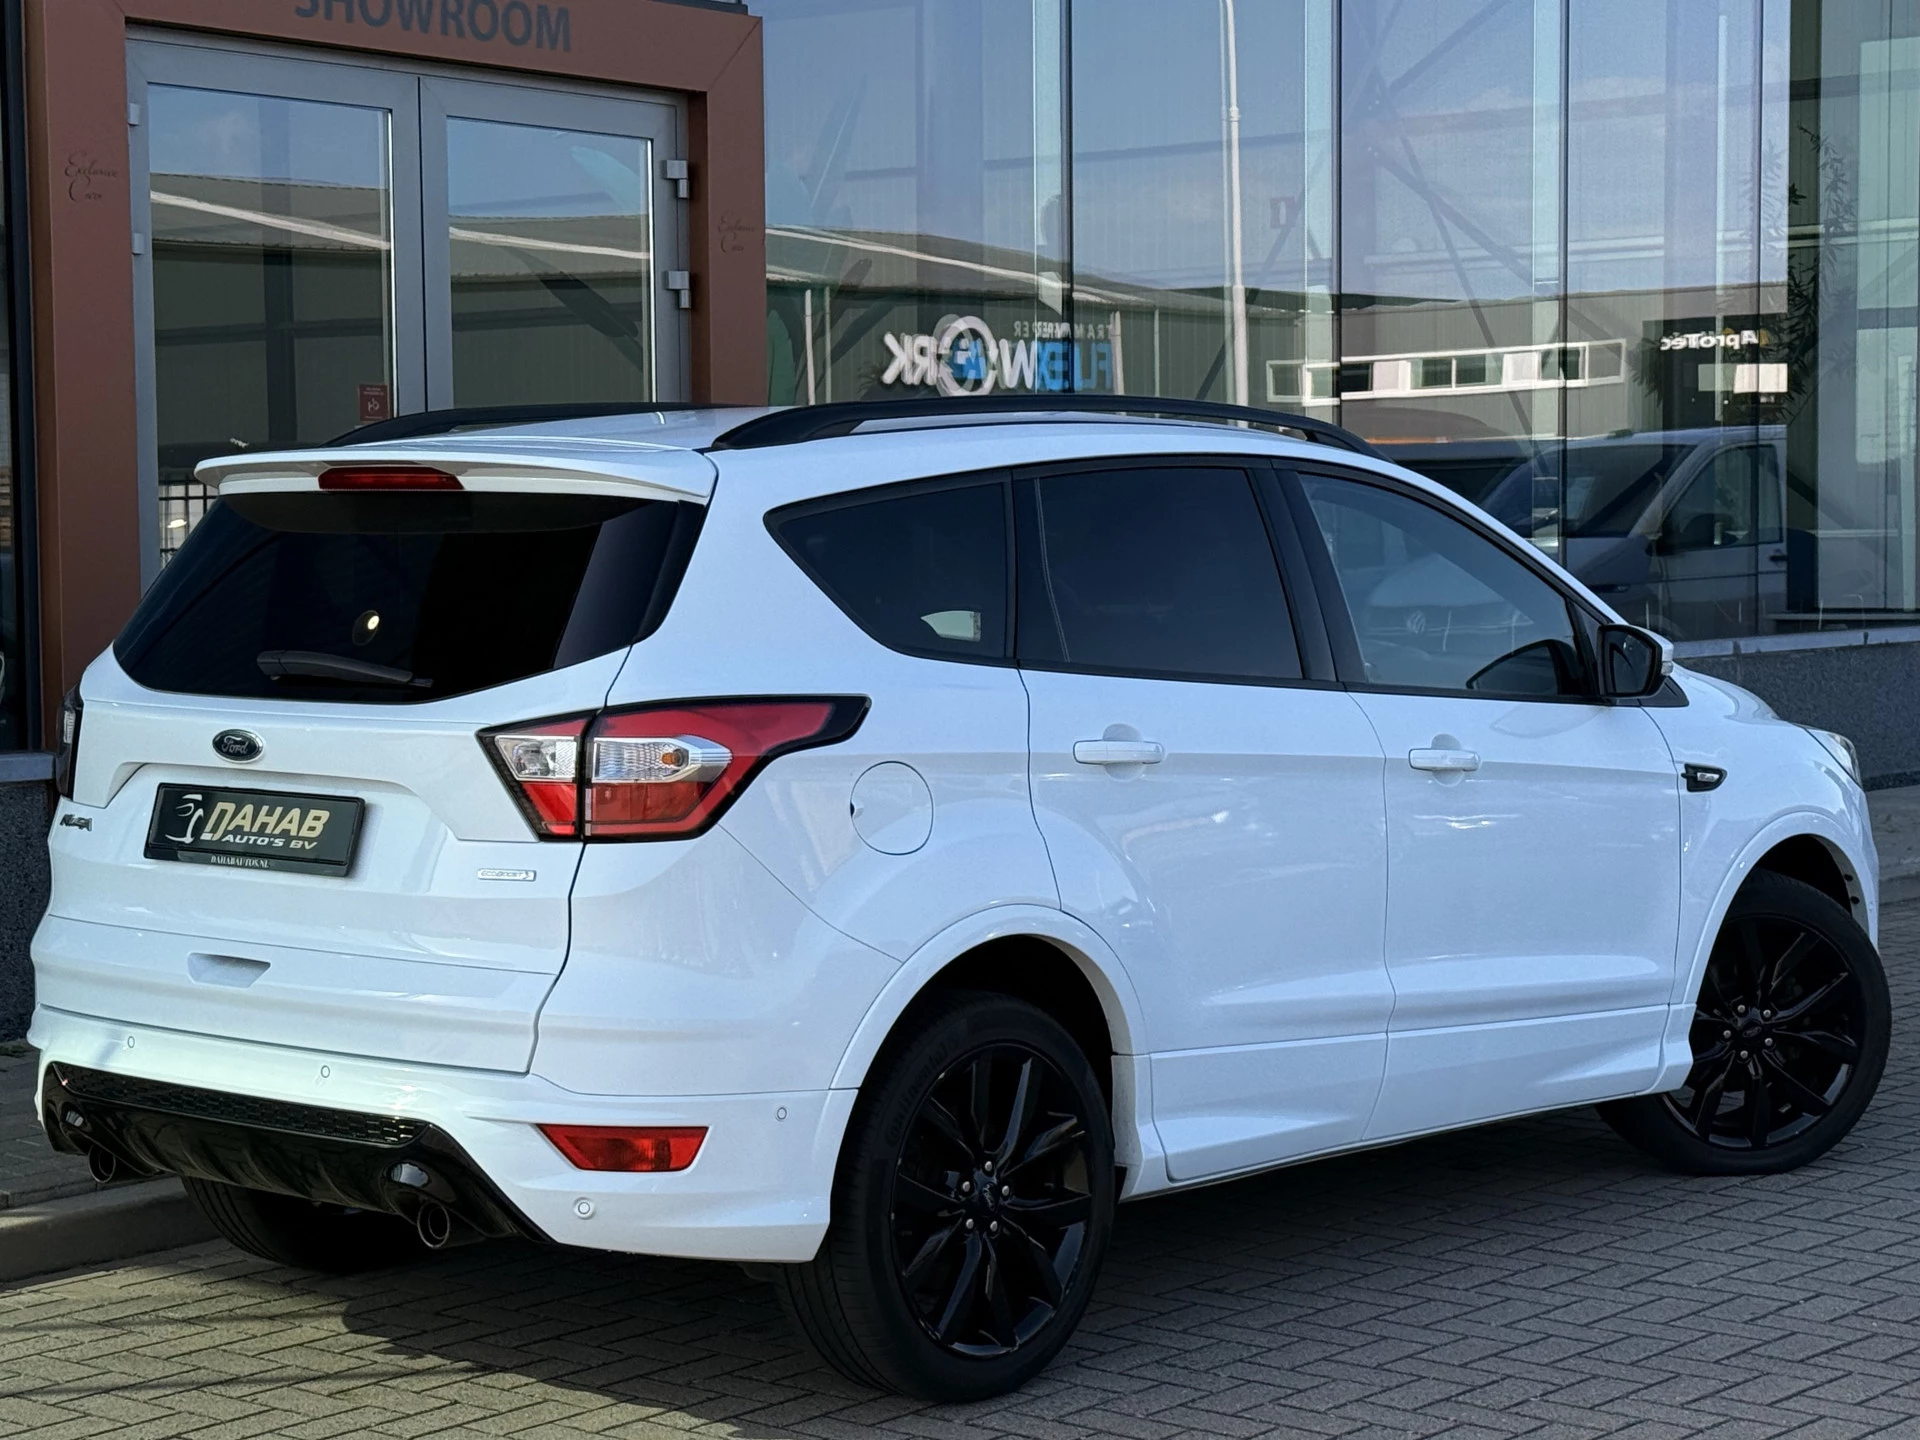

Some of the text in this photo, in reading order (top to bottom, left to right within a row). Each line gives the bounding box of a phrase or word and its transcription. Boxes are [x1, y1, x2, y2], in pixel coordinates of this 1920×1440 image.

[221, 734, 250, 755] Ford
[203, 801, 331, 841] DAHAB
[222, 833, 318, 850] AUTO'S BV
